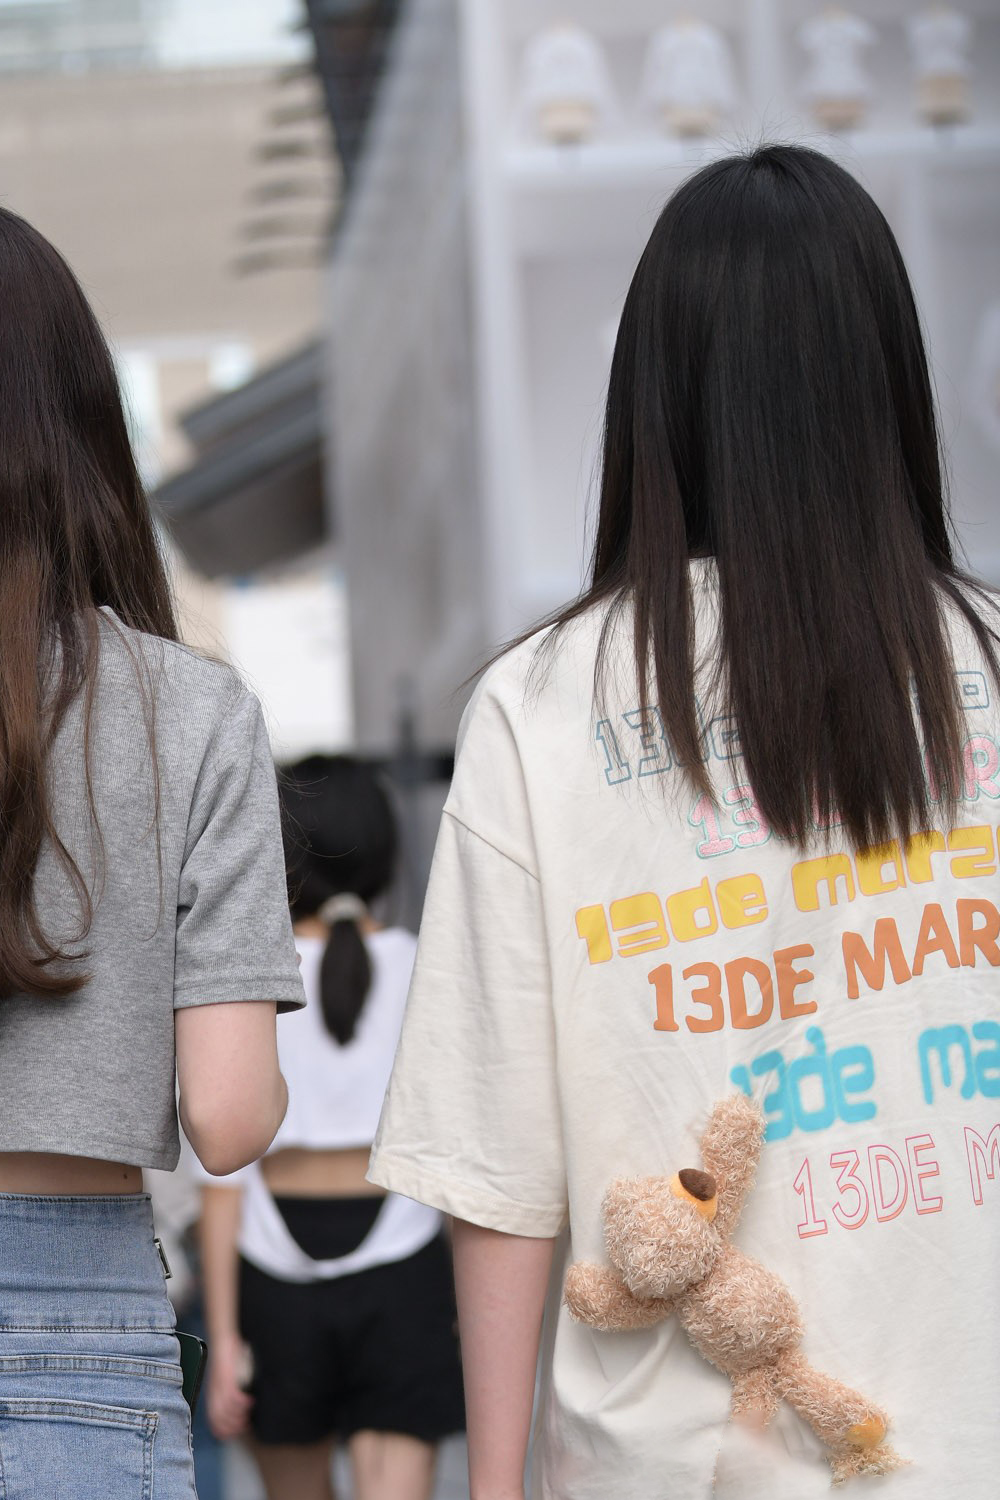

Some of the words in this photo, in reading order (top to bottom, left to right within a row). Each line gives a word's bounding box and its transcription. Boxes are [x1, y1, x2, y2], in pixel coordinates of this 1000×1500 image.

[575, 874, 769, 965] 13de
[791, 825, 1000, 913] marz
[648, 943, 818, 1033] 13DE
[793, 1133, 943, 1239] 13DE
